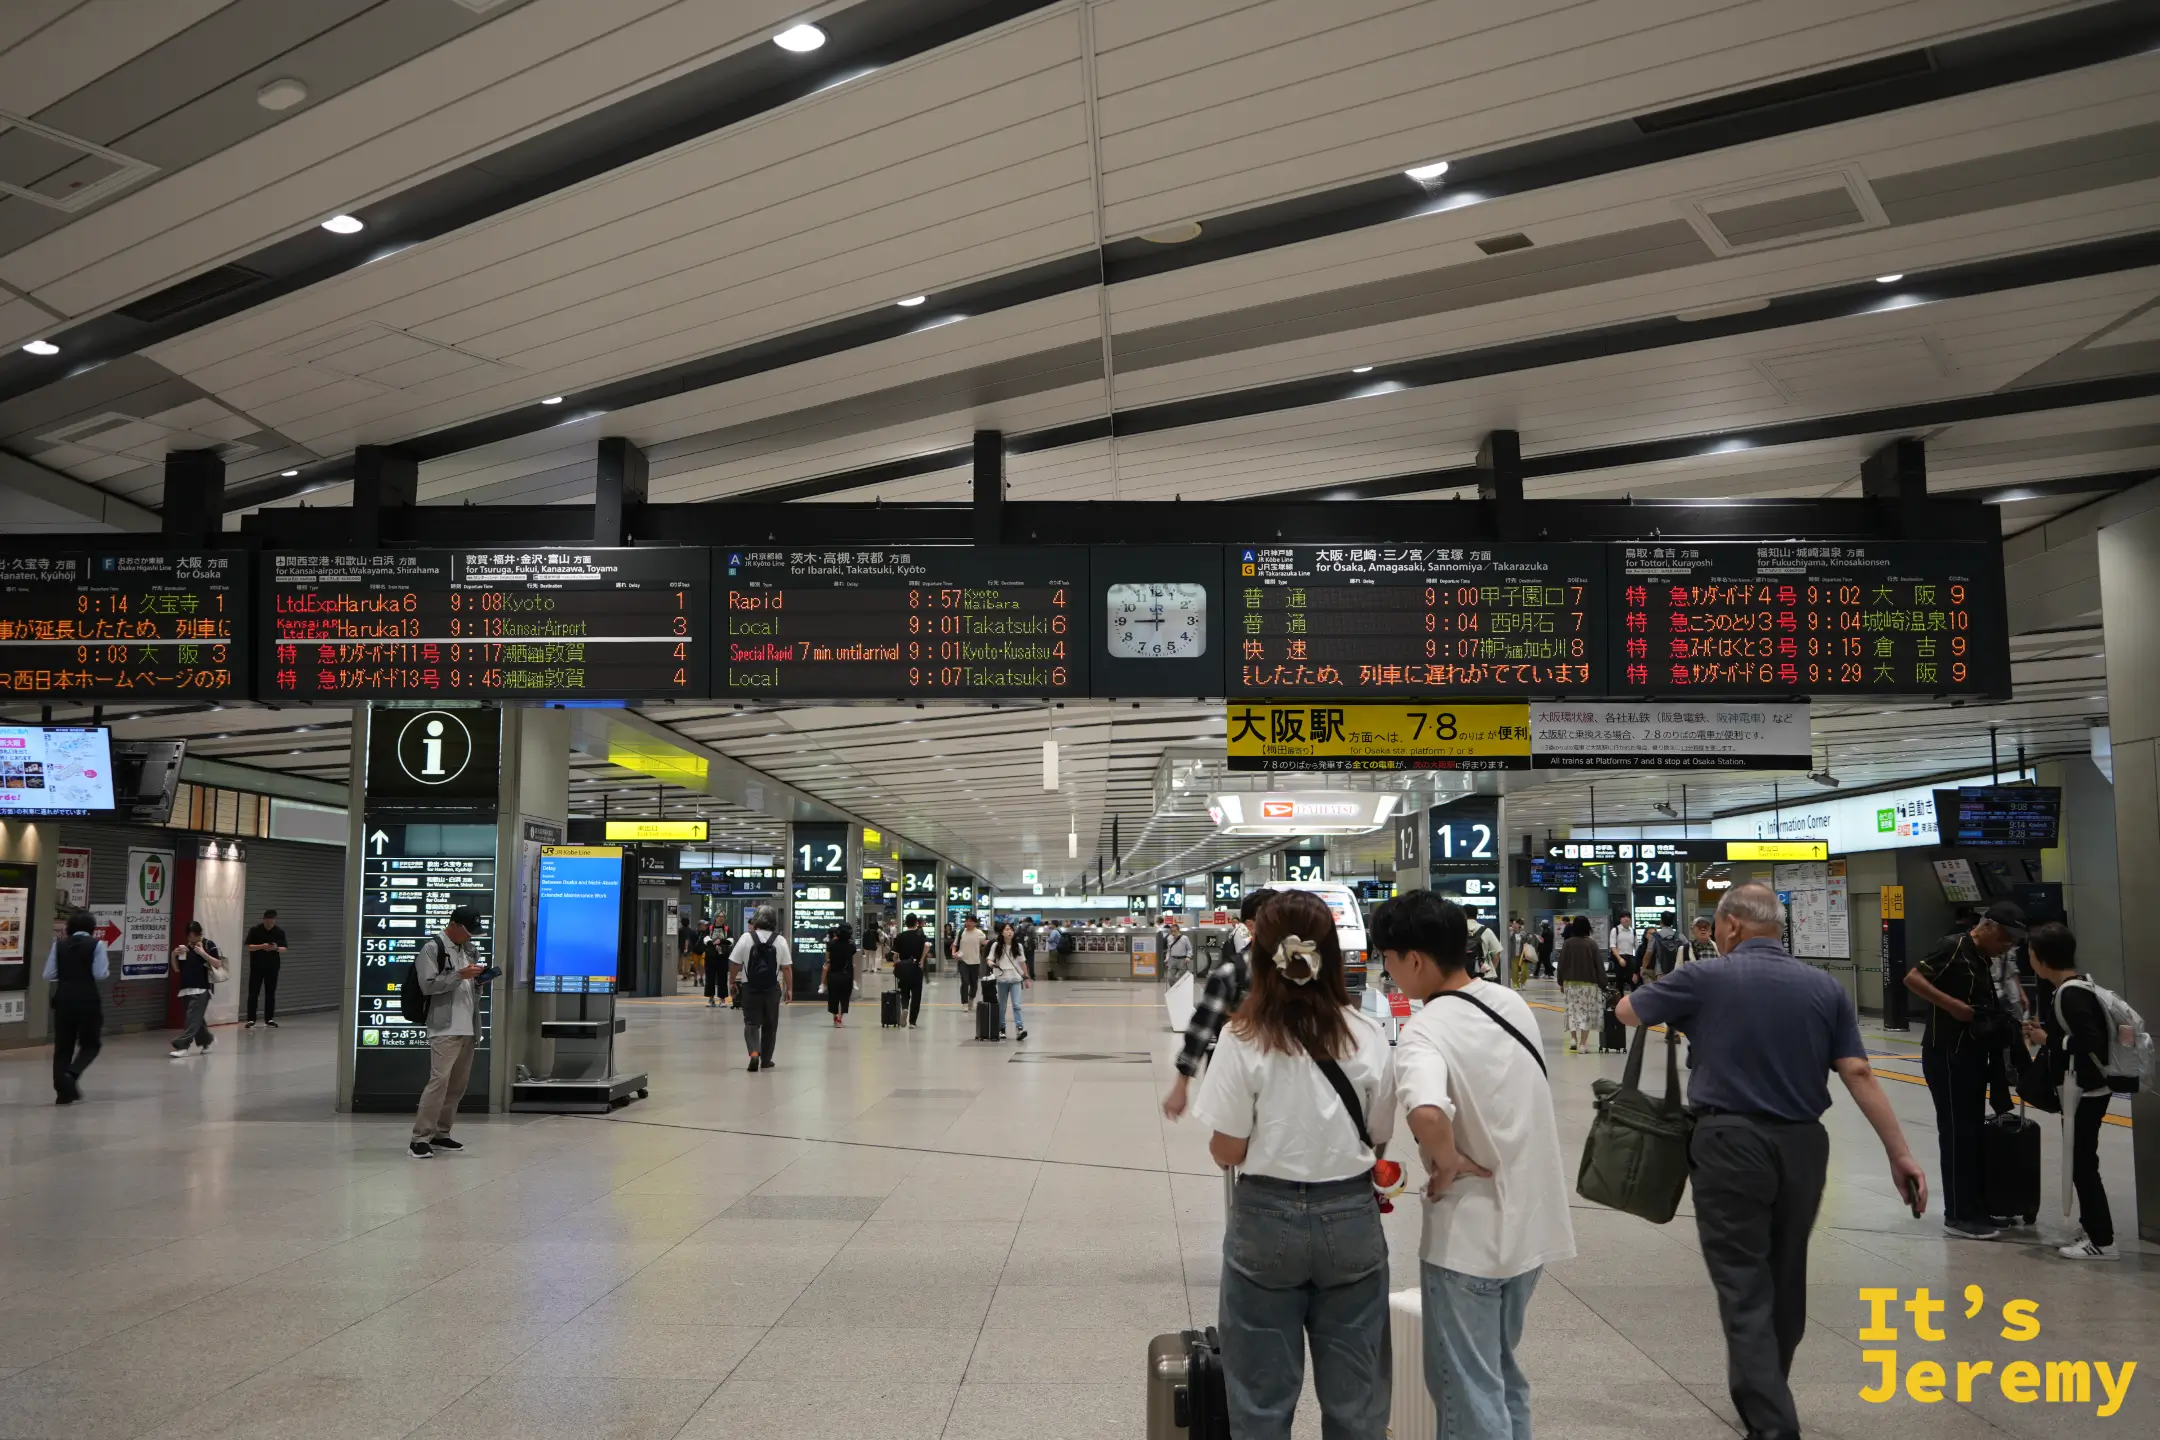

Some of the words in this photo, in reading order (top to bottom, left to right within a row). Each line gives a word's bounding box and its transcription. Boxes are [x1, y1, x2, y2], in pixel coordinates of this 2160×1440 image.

[286, 556, 395, 566] 関西空港・和歌山・白浜
[399, 557, 417, 566] 方面
[466, 554, 570, 565] 敦賀・福井・金沢・富山
[574, 555, 591, 564] 方面
[745, 553, 783, 561] JR京都線
[791, 552, 883, 564] 茨木・高槻・京都
[889, 554, 911, 564] 方面
[1470, 551, 1491, 561] 方面
[1625, 548, 1676, 558] 鳥取・倉吉
[1681, 549, 1699, 558] 方面
[1757, 547, 1842, 558] 福知山・城崎温泉
[1847, 549, 1865, 558] 方面
[177, 556, 202, 569] 大阪
[208, 558, 228, 569] 方面
[276, 567, 287, 575] for
[289, 567, 347, 576] Kansai-airport,
[349, 566, 395, 576] Wakayama,
[397, 566, 440, 575] Shirahama
[466, 565, 478, 573] for
[480, 565, 514, 575] Tsuruga,
[515, 565, 540, 574] Fukui,
[541, 565, 585, 574] Kanazawa,
[587, 565, 618, 574] Toyama
[791, 565, 805, 574] for
[808, 565, 844, 575] Ibaraki,
[846, 565, 895, 575] Takatsuki,
[897, 565, 926, 576] Kyōto
[1257, 563, 1293, 571] JR宝塚線
[1316, 562, 1330, 571] for
[1334, 562, 1366, 573] Ōsaka,
[1368, 562, 1426, 573] Amagasaki,
[1626, 559, 1639, 567] for
[1640, 559, 1670, 568] Tottori,
[1672, 559, 1713, 568] Kurayoshi
[1772, 558, 1828, 568] Fukuchiyama,
[1830, 558, 1890, 567] Kinosakionsen
[176, 570, 191, 578] for
[77, 594, 128, 613] 9:14
[139, 593, 200, 614] 久宝寺
[216, 593, 223, 612] 1
[338, 593, 399, 612] Haruka
[403, 593, 417, 612] 6
[451, 593, 502, 611] 9:08
[502, 593, 555, 612] Kyoto
[676, 592, 683, 610] 1
[729, 590, 783, 610] Rapid
[909, 589, 962, 608] 8:57
[964, 589, 999, 599] Kyoto
[1052, 589, 1065, 608] 4
[1425, 587, 1478, 606] 9:00
[1480, 585, 1564, 607] 甲子園口
[1571, 587, 1583, 605] 7
[1807, 585, 1861, 605] 9:02
[1951, 585, 1965, 605] 9
[964, 599, 1020, 610] Maibara
[1124, 604, 1136, 613] 10
[277, 619, 319, 629] Kansai
[338, 619, 399, 637] Haruka
[401, 619, 419, 637] 13
[451, 618, 502, 636] 9:13
[502, 618, 587, 637] Kansai-Airport
[673, 617, 687, 636] 3
[729, 616, 778, 635] Local
[909, 615, 960, 634] 9:01
[963, 615, 1048, 634] Takatsuki
[1052, 615, 1066, 634] 6
[1118, 617, 1127, 626] 9
[1187, 616, 1195, 625] 3
[1425, 612, 1478, 632] 9:04
[1491, 612, 1554, 633] 西明石
[1571, 612, 1583, 632] 7
[1808, 611, 1861, 631] 9:04
[1862, 610, 1948, 632] 城崎温泉
[1949, 611, 1968, 630] 10
[1124, 632, 1133, 641] 8
[1180, 632, 1189, 640] 4
[77, 645, 128, 664] 9:03
[212, 644, 226, 663] 3
[451, 644, 501, 662] 9:17
[673, 642, 686, 661] 4
[730, 643, 765, 662] Special
[767, 643, 793, 662] Rapid
[798, 641, 810, 661] 7
[813, 644, 834, 661] min.
[909, 641, 960, 660] 9:01
[1052, 641, 1065, 660] 4
[1425, 639, 1478, 658] 9:07
[1571, 638, 1584, 657] 8
[1808, 637, 1862, 657] 9:15
[1952, 636, 1966, 656] 9
[451, 669, 501, 688] 9:45
[673, 668, 686, 686] 4
[729, 667, 778, 686] Local
[909, 667, 962, 686] 9:07
[963, 667, 1048, 686] Takatsuki
[1052, 666, 1066, 686] 6
[1808, 663, 1863, 683] 9:29
[1952, 662, 1967, 683] 9
[1410, 747, 1445, 755] platform
[1596, 757, 1631, 765] Platforms
[1664, 758, 1680, 766] stop
[1767, 818, 1807, 834] Infrmation
[1807, 815, 1831, 829] Corner
[380, 876, 388, 887] 2
[379, 892, 387, 903] 3
[377, 918, 387, 929] 4
[373, 999, 382, 1010] 9
[370, 1014, 384, 1025] 10
